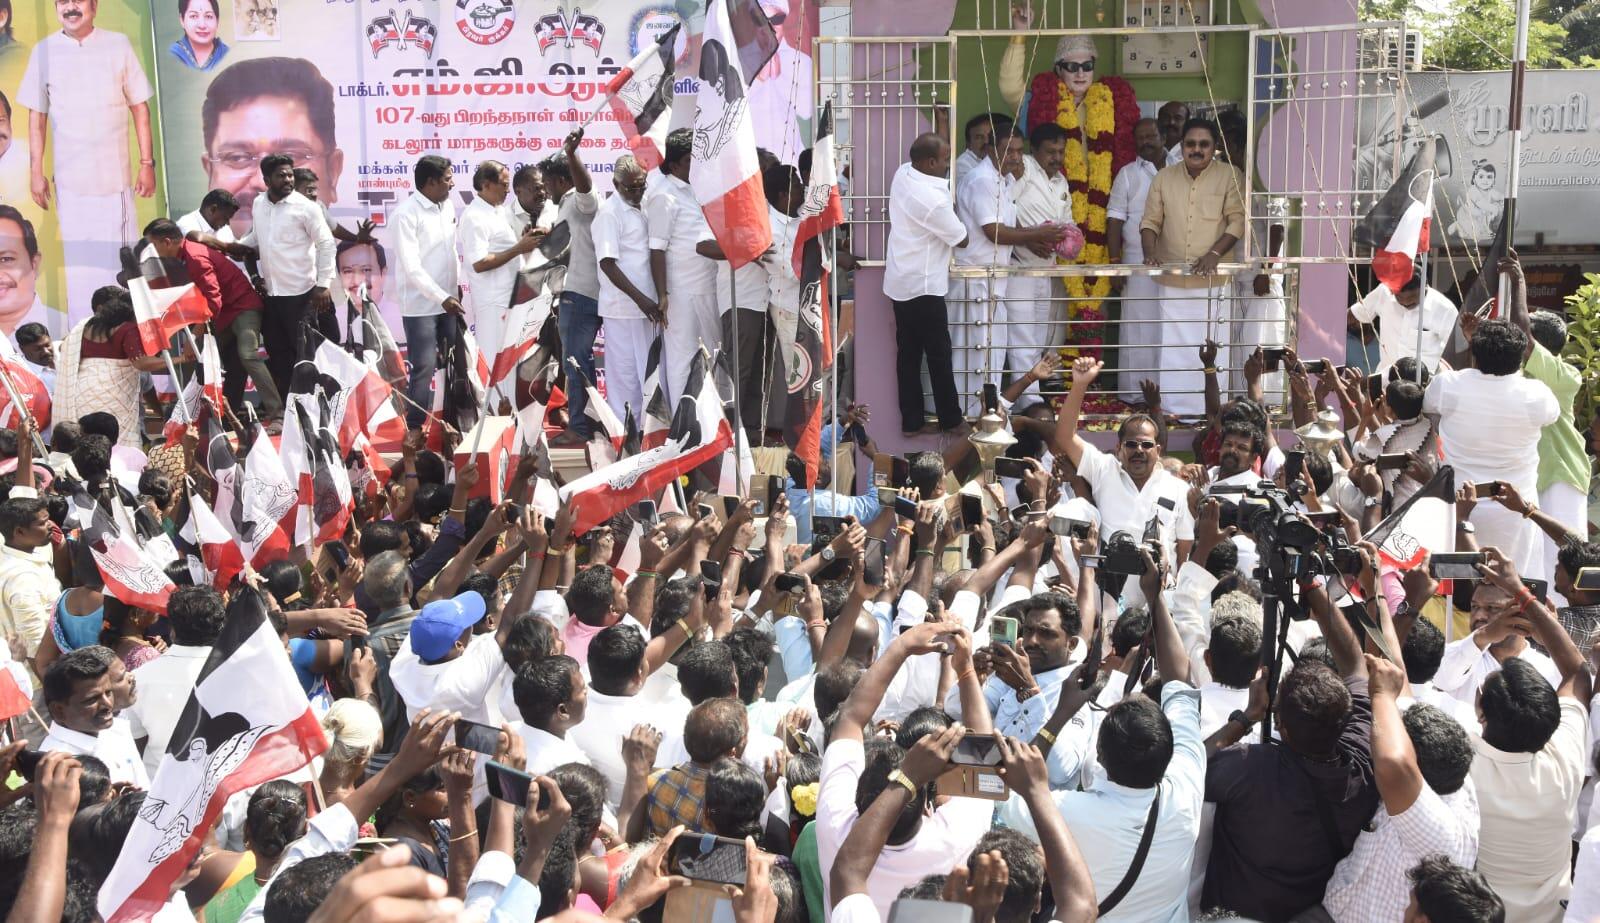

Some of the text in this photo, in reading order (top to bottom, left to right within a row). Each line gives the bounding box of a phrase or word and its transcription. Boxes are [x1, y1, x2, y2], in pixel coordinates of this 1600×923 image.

[1194, 15, 1201, 24] 2
[1129, 52, 1137, 61] 8
[1190, 50, 1197, 59] 4
[1145, 60, 1153, 70] 7
[1160, 62, 1168, 71] 6
[1175, 60, 1183, 69] 5
[454, 108, 555, 126] பிறந்தநாள்
[447, 131, 542, 153] மாநகருக்கு
[546, 137, 607, 149] வகை
[357, 160, 409, 176] மக்கள்
